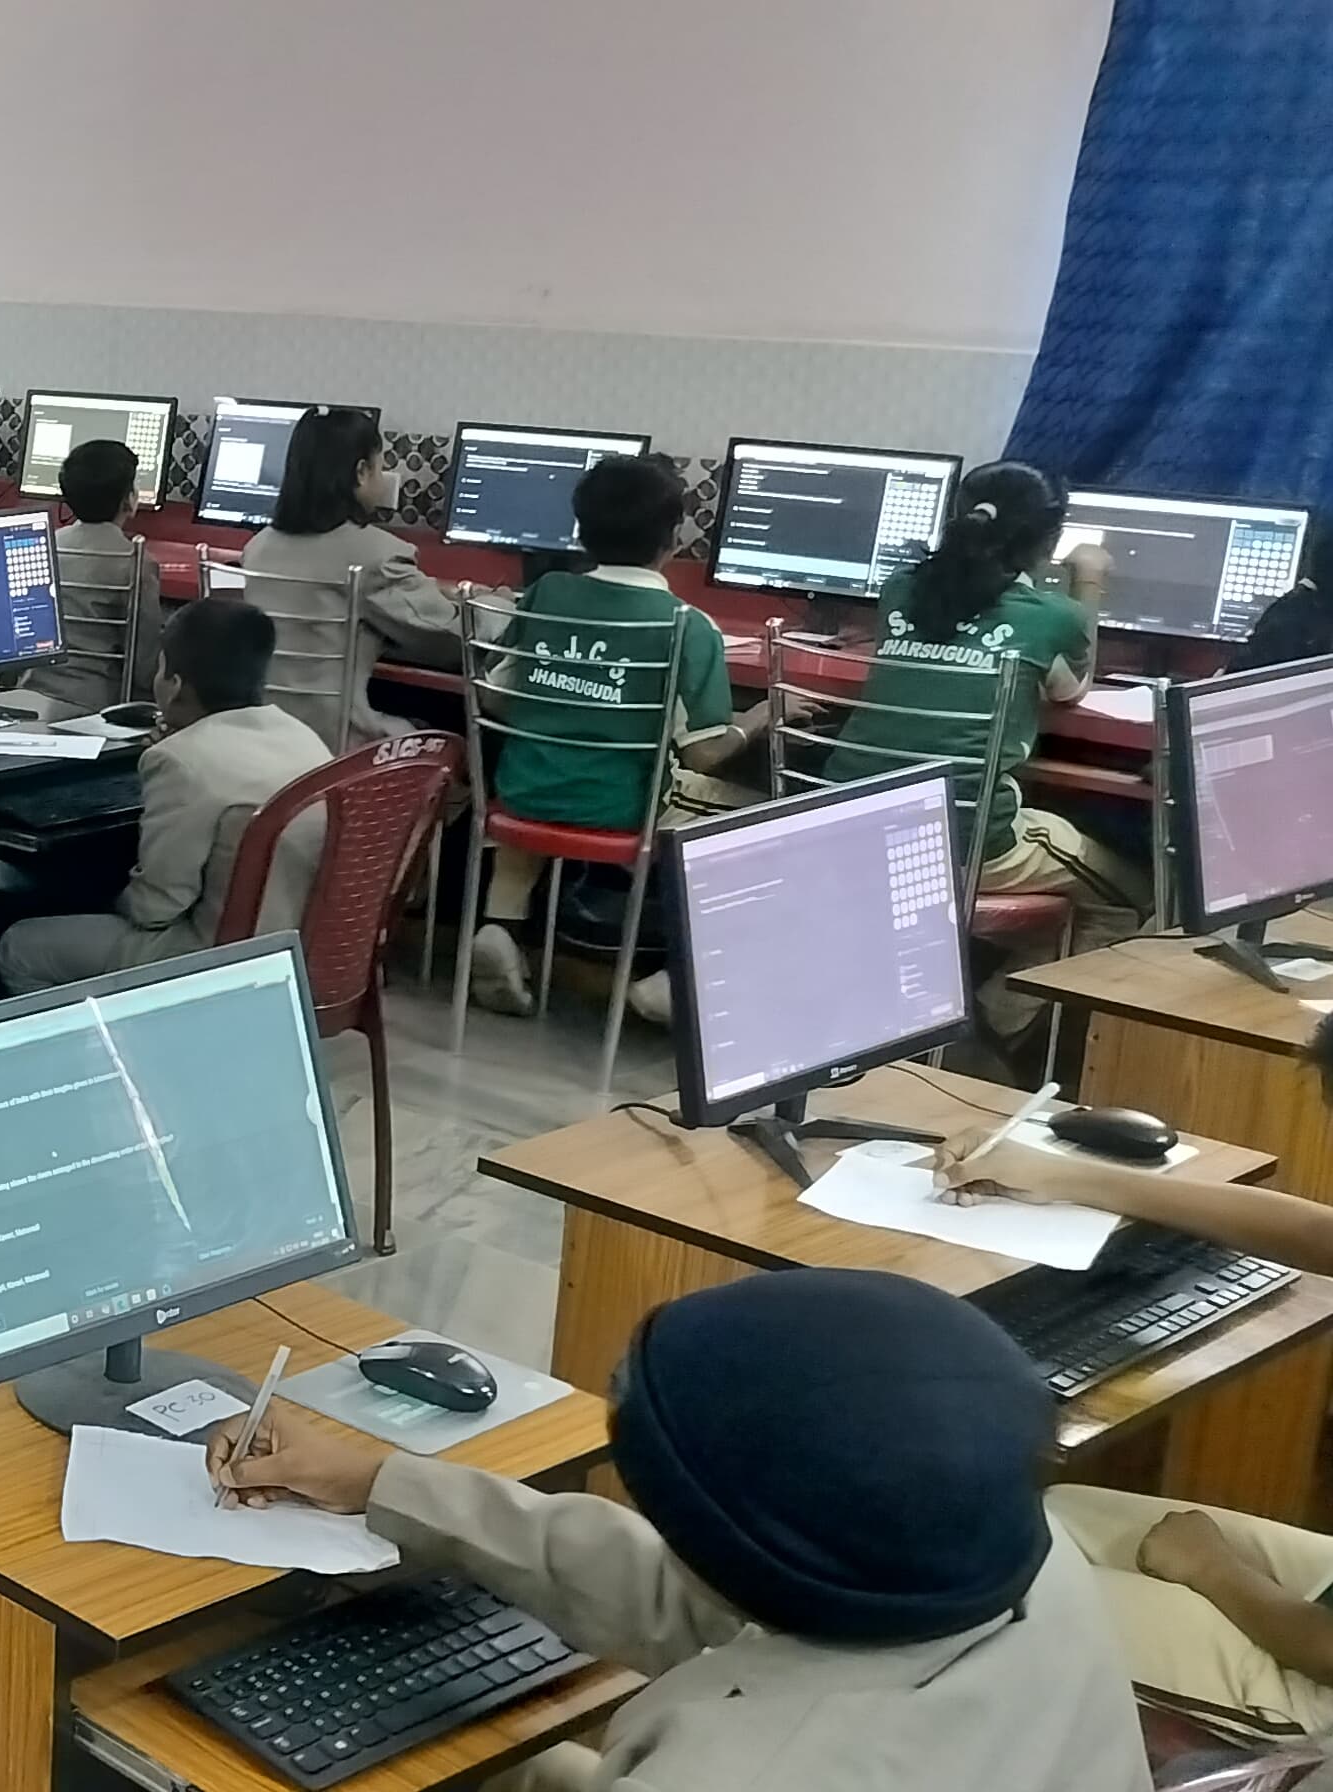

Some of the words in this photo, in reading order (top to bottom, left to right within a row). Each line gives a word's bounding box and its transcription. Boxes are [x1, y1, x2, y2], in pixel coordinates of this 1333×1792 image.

[877, 639, 995, 669] JHARSUGUDA
[528, 668, 622, 704] JHARSUGUDA
[152, 1401, 186, 1422] PC
[187, 1391, 215, 1406] 30
